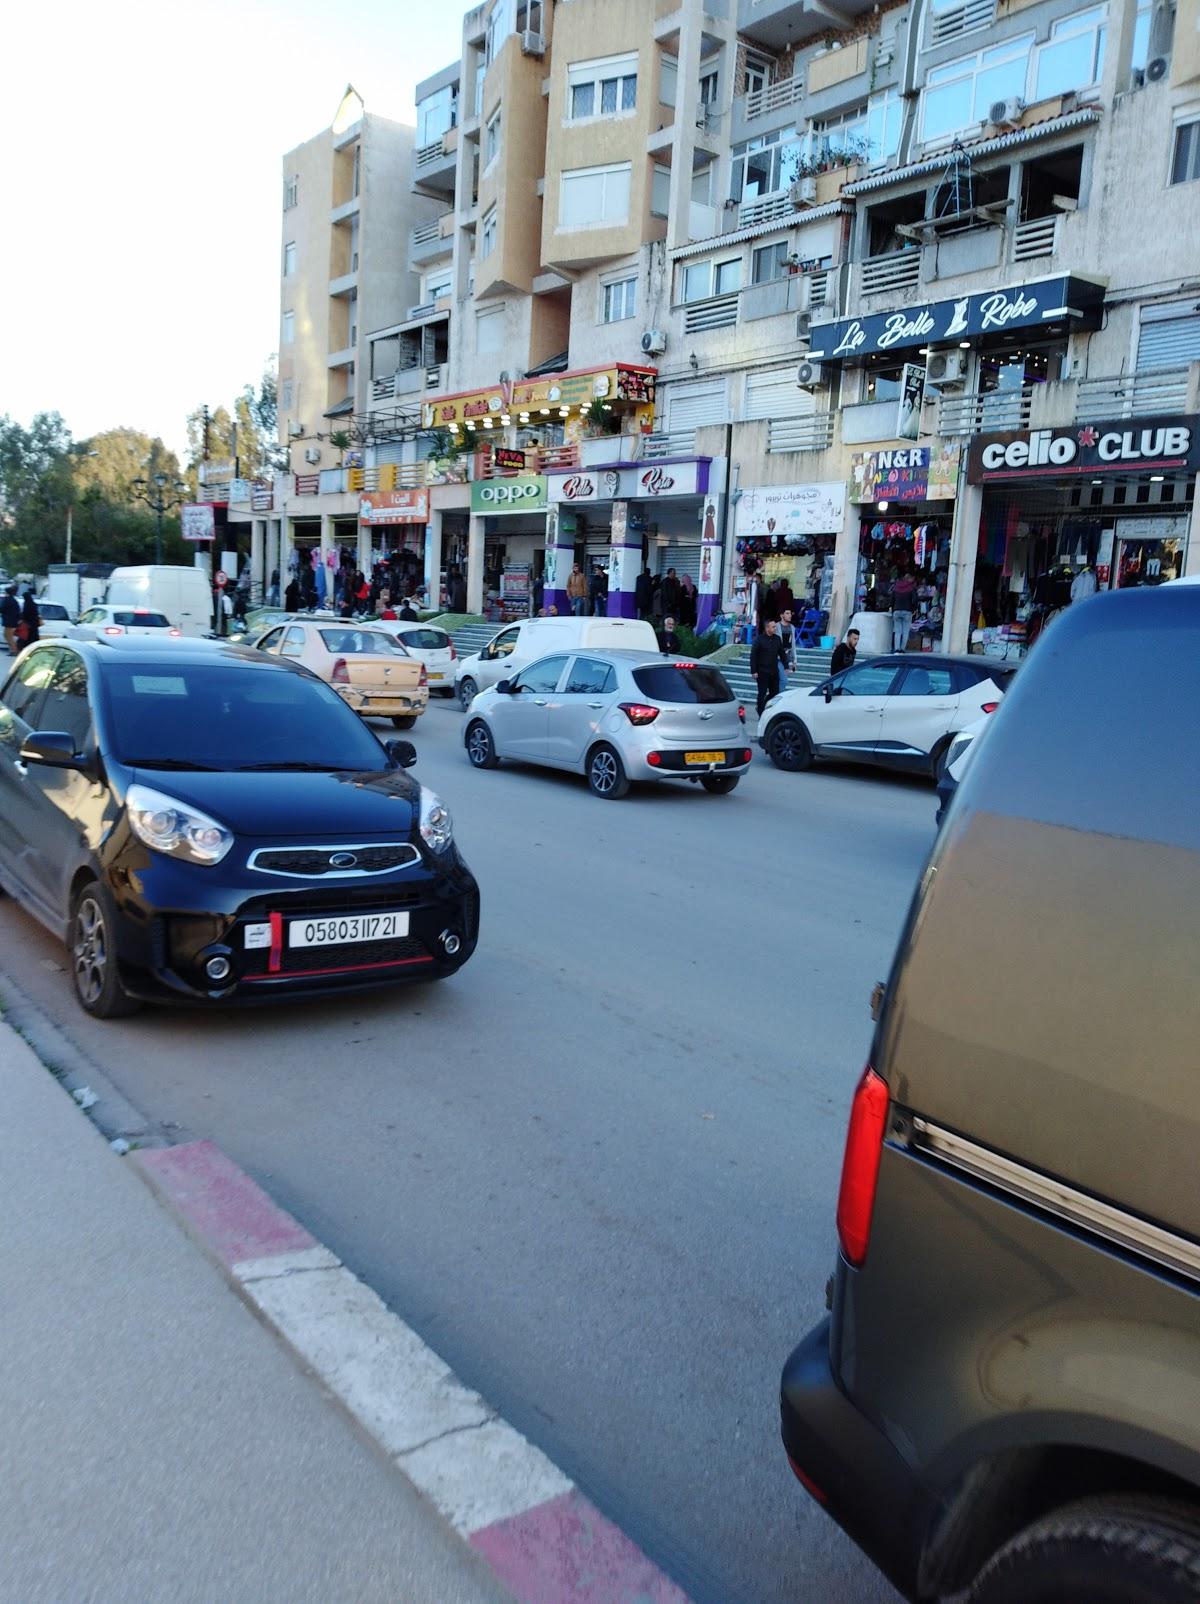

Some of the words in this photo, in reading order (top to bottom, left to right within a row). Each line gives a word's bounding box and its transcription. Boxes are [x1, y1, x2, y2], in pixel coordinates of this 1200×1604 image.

[833, 321, 867, 355] La
[877, 311, 935, 348] Belle
[980, 292, 1038, 330] Robe
[878, 448, 922, 469] N&R
[982, 430, 1077, 470] celio
[1098, 427, 1191, 461] CLUB
[480, 483, 539, 504] oppo
